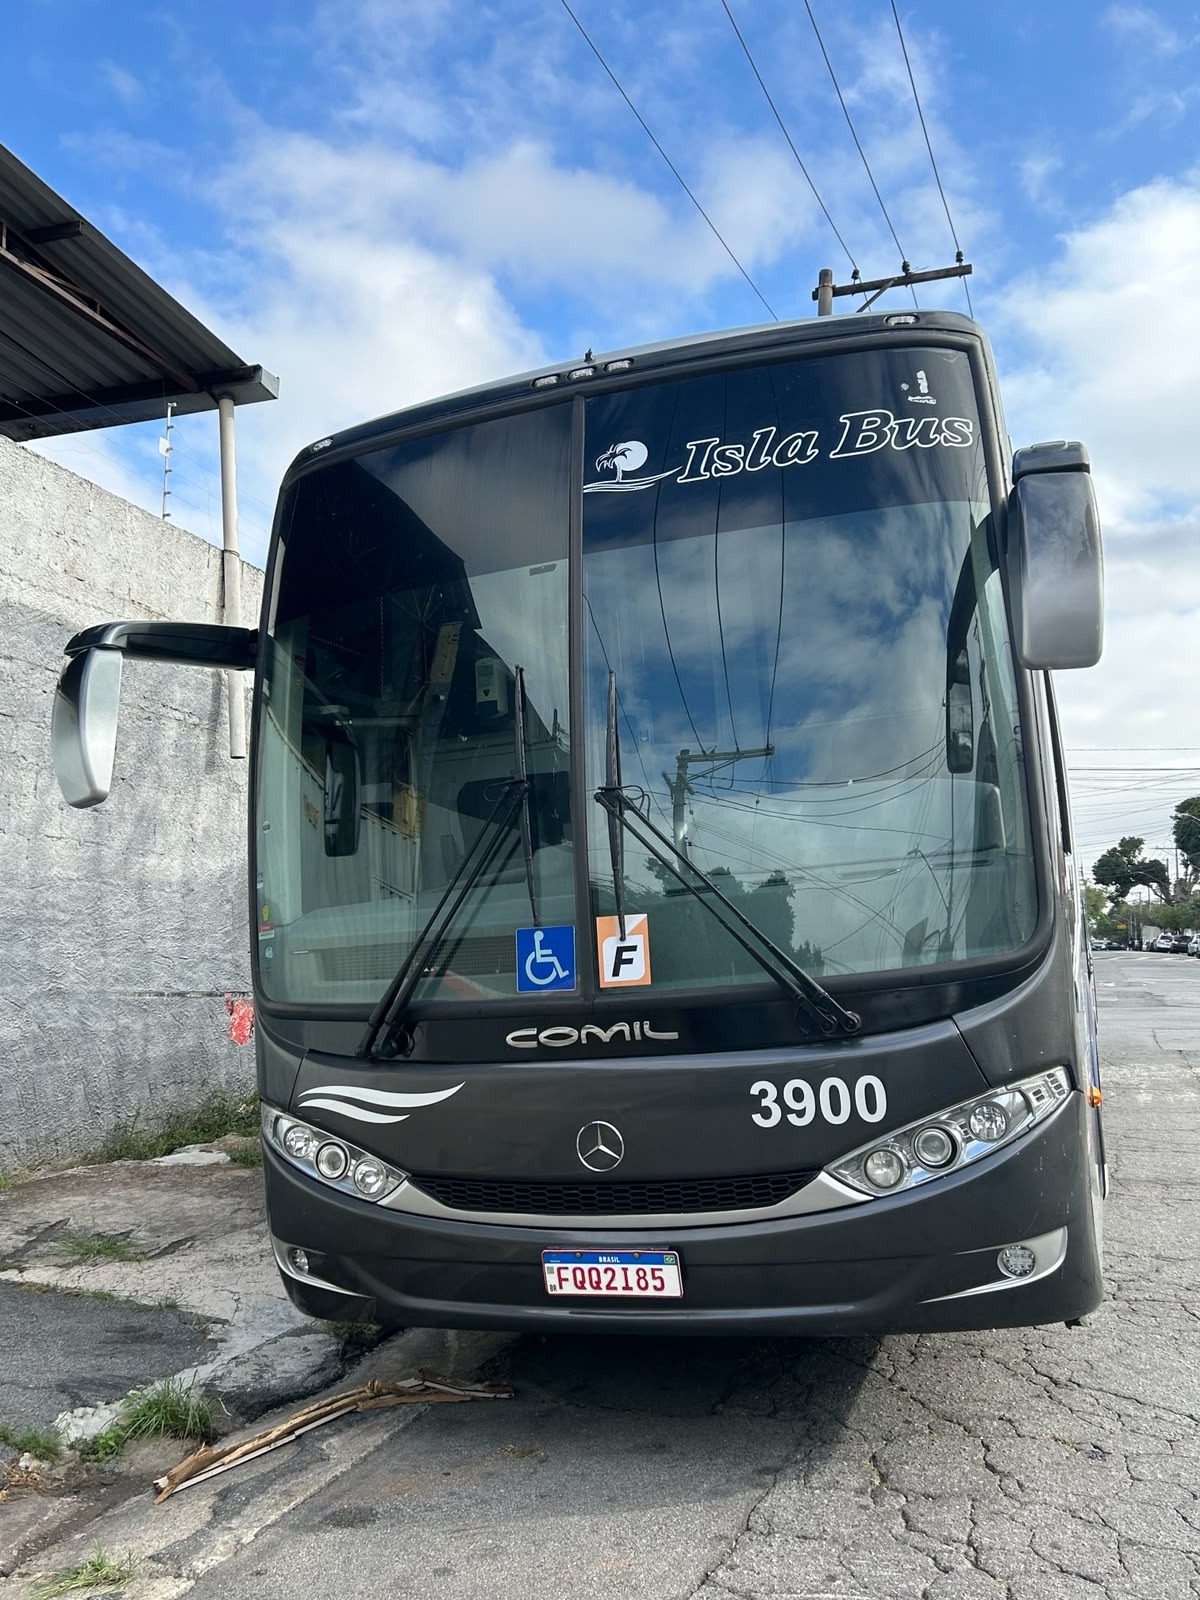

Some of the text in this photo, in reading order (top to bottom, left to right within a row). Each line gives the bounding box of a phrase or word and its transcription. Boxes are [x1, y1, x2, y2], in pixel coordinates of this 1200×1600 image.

[677, 409, 973, 483] Isla Bus
[611, 944, 638, 978] F
[505, 1020, 679, 1049] COMIL
[749, 1074, 888, 1128] 3900
